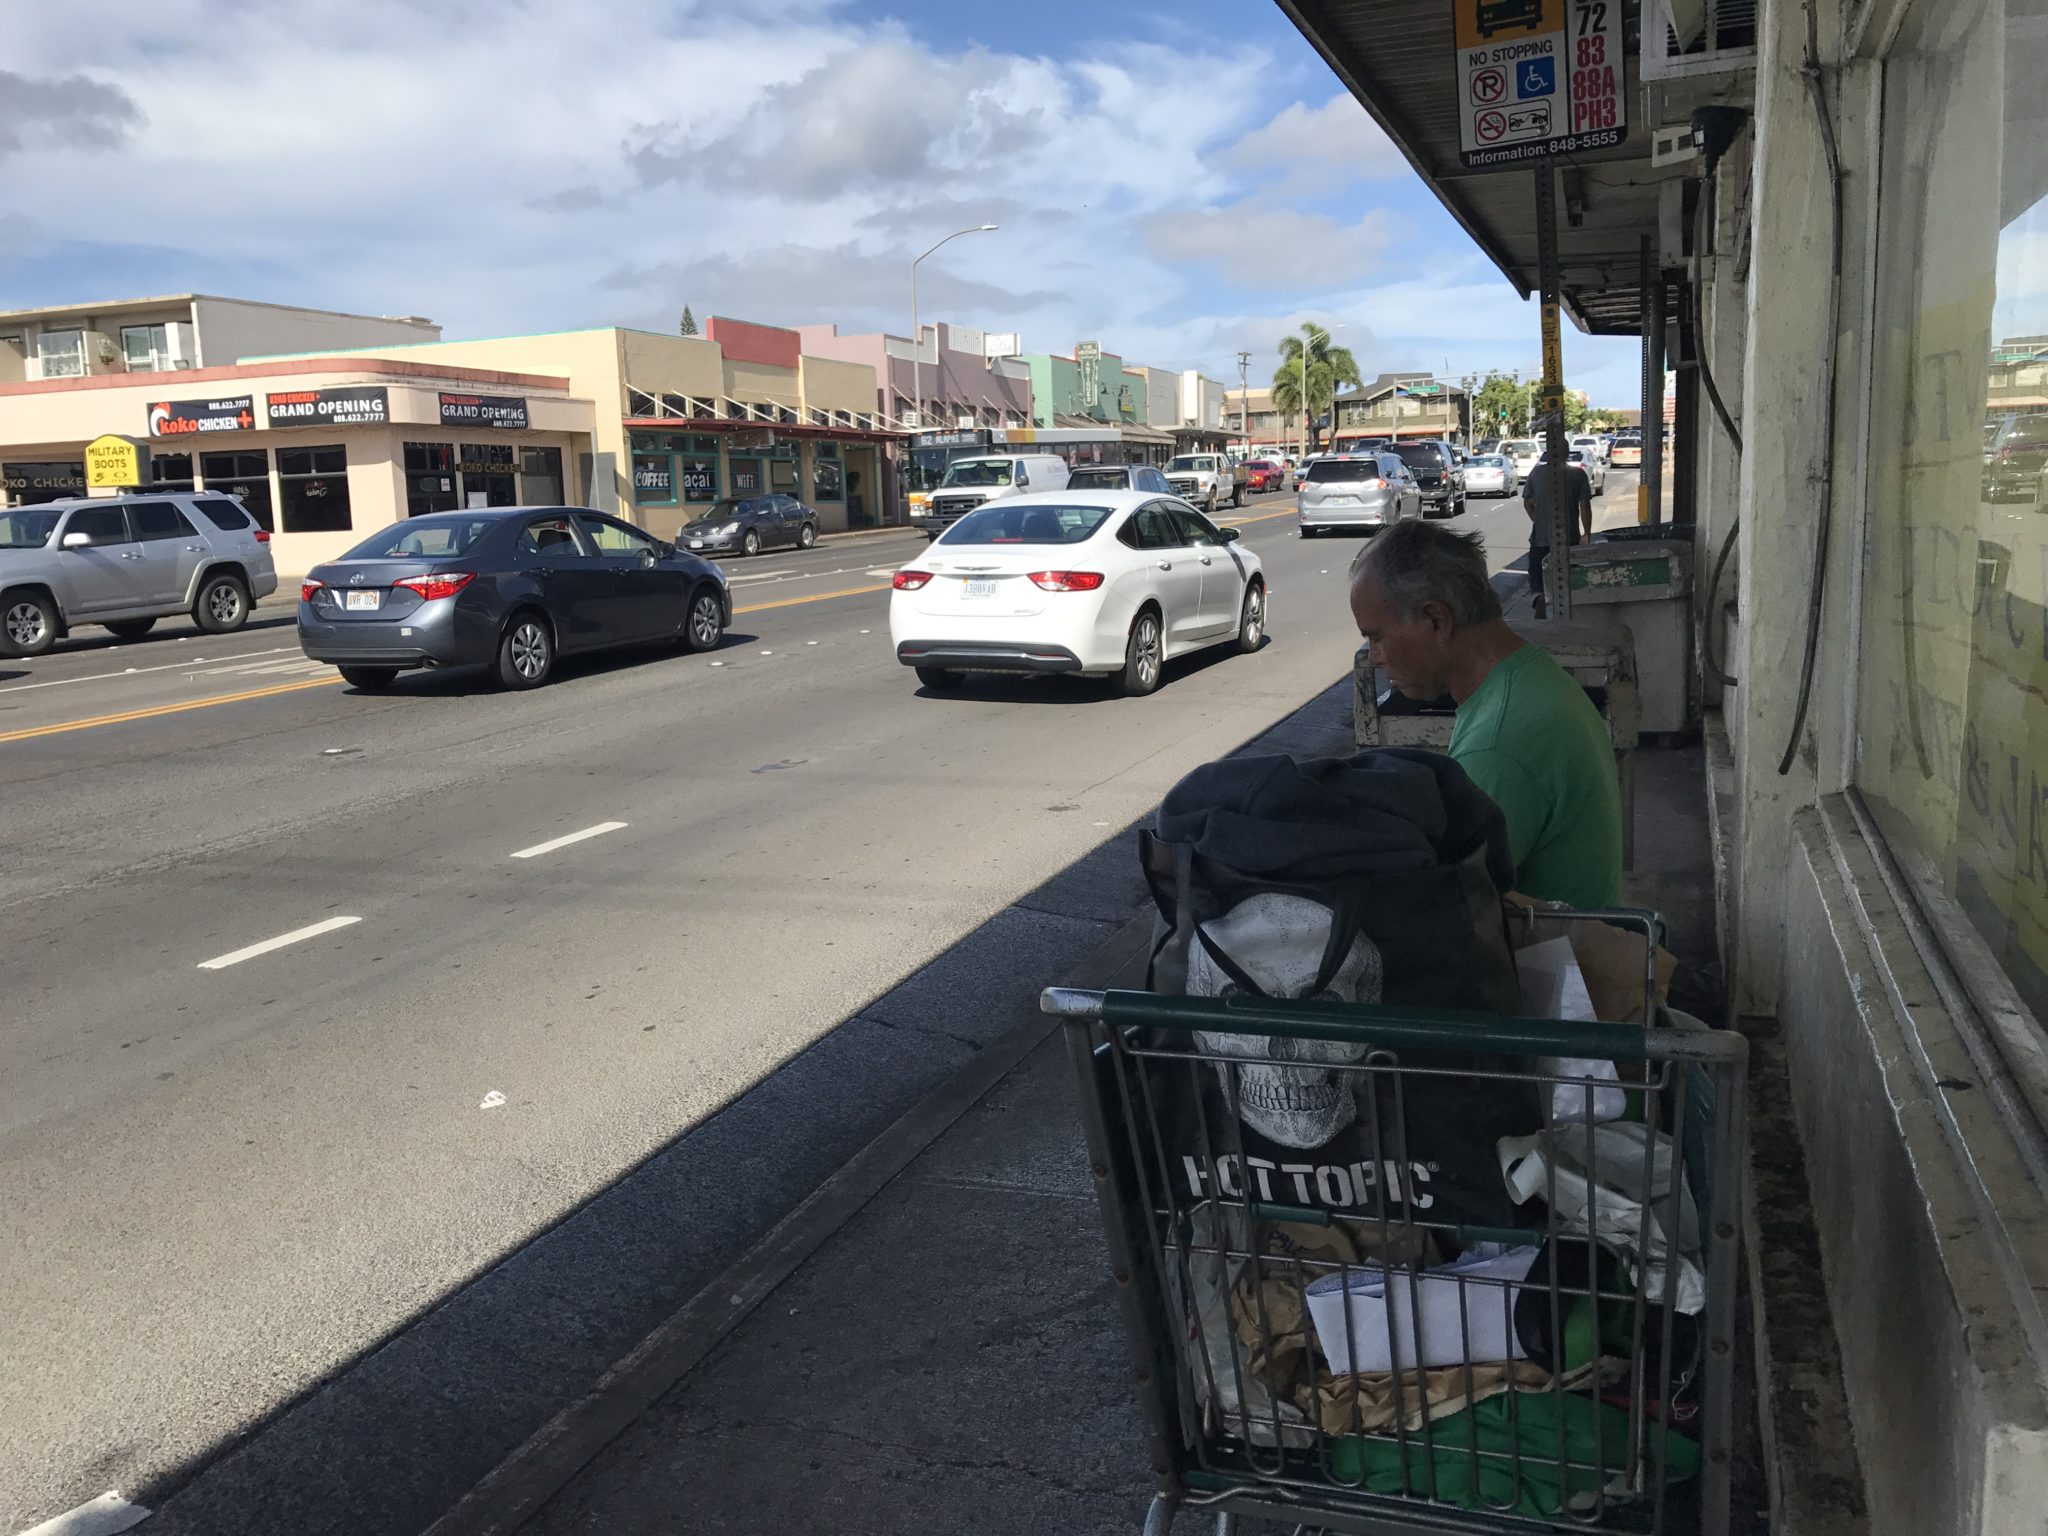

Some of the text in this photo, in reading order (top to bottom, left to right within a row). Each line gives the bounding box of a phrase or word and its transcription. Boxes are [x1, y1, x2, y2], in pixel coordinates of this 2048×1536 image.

[1576, 2, 1607, 36] 72
[1469, 39, 1553, 66] NO STOPPING
[1577, 34, 1605, 68] 83
[1573, 65, 1616, 101] 88A
[1574, 97, 1617, 132] PH3
[1469, 131, 1618, 166] Information: 848-5555
[270, 399, 383, 418] GRAND OPENING
[333, 413, 385, 423] 808.622.7777
[442, 405, 524, 419] GRAND OPENING
[198, 416, 239, 431] CHICKEN
[88, 446, 132, 457] MILITARY
[94, 458, 127, 469] BOOTS
[635, 471, 669, 487] COFFEE
[1281, 1159, 1434, 1209] TOPIC
